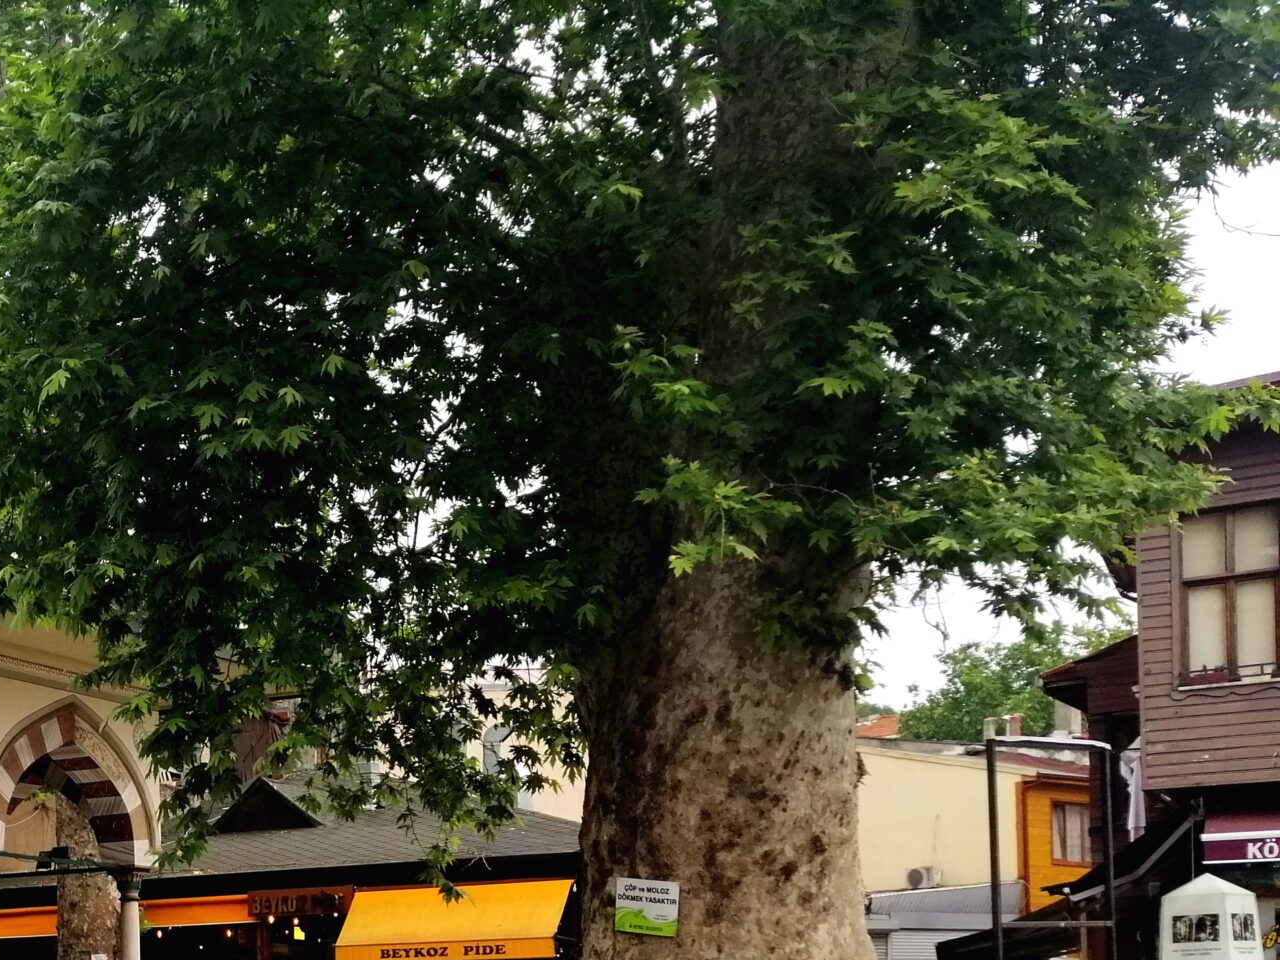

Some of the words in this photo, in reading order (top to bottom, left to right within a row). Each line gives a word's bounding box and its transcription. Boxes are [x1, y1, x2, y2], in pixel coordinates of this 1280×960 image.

[646, 887, 670, 895] MOLOZ
[618, 893, 643, 902] DÖKMEK
[645, 896, 677, 905] YASAKTIR
[380, 946, 449, 959] BEYKOZ
[463, 943, 506, 956] PİDE
